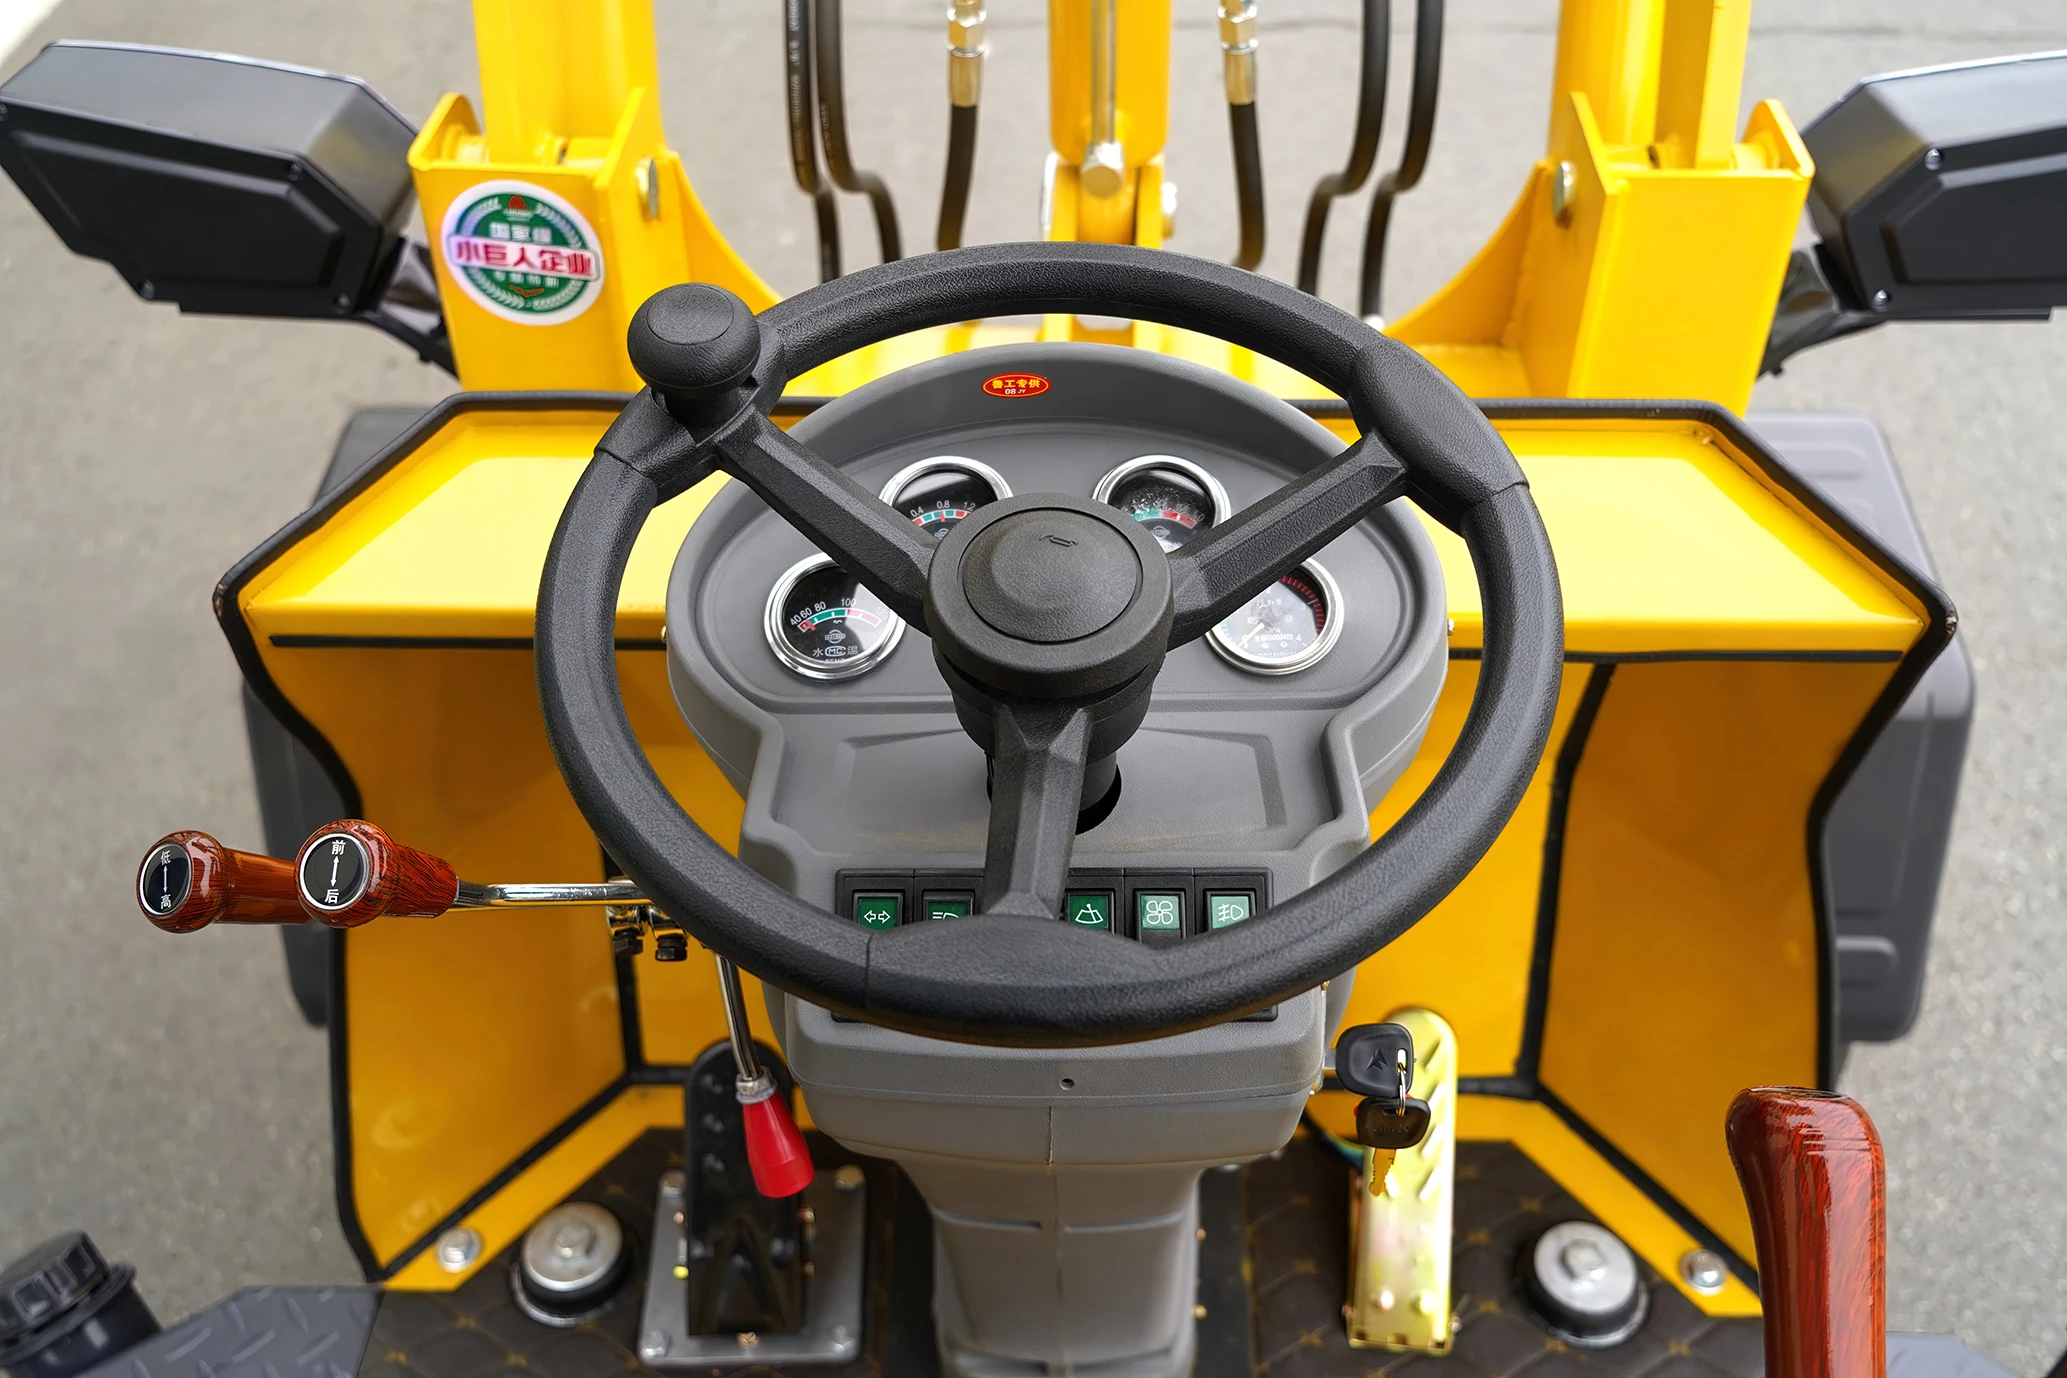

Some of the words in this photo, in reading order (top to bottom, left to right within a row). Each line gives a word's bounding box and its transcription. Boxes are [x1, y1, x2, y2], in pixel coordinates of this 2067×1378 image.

[457, 241, 592, 277] 小巨人企业
[992, 379, 1040, 389] 鲁工专供
[936, 500, 950, 510] 0.8
[910, 507, 924, 518] 0.4
[814, 601, 827, 612] 80
[841, 598, 857, 607] 100
[800, 607, 813, 619] 60
[790, 615, 802, 626] 40
[813, 648, 824, 657] 水
[331, 839, 346, 856] 前
[160, 850, 171, 865] 低
[160, 893, 172, 910] 高
[325, 888, 340, 904] 后
